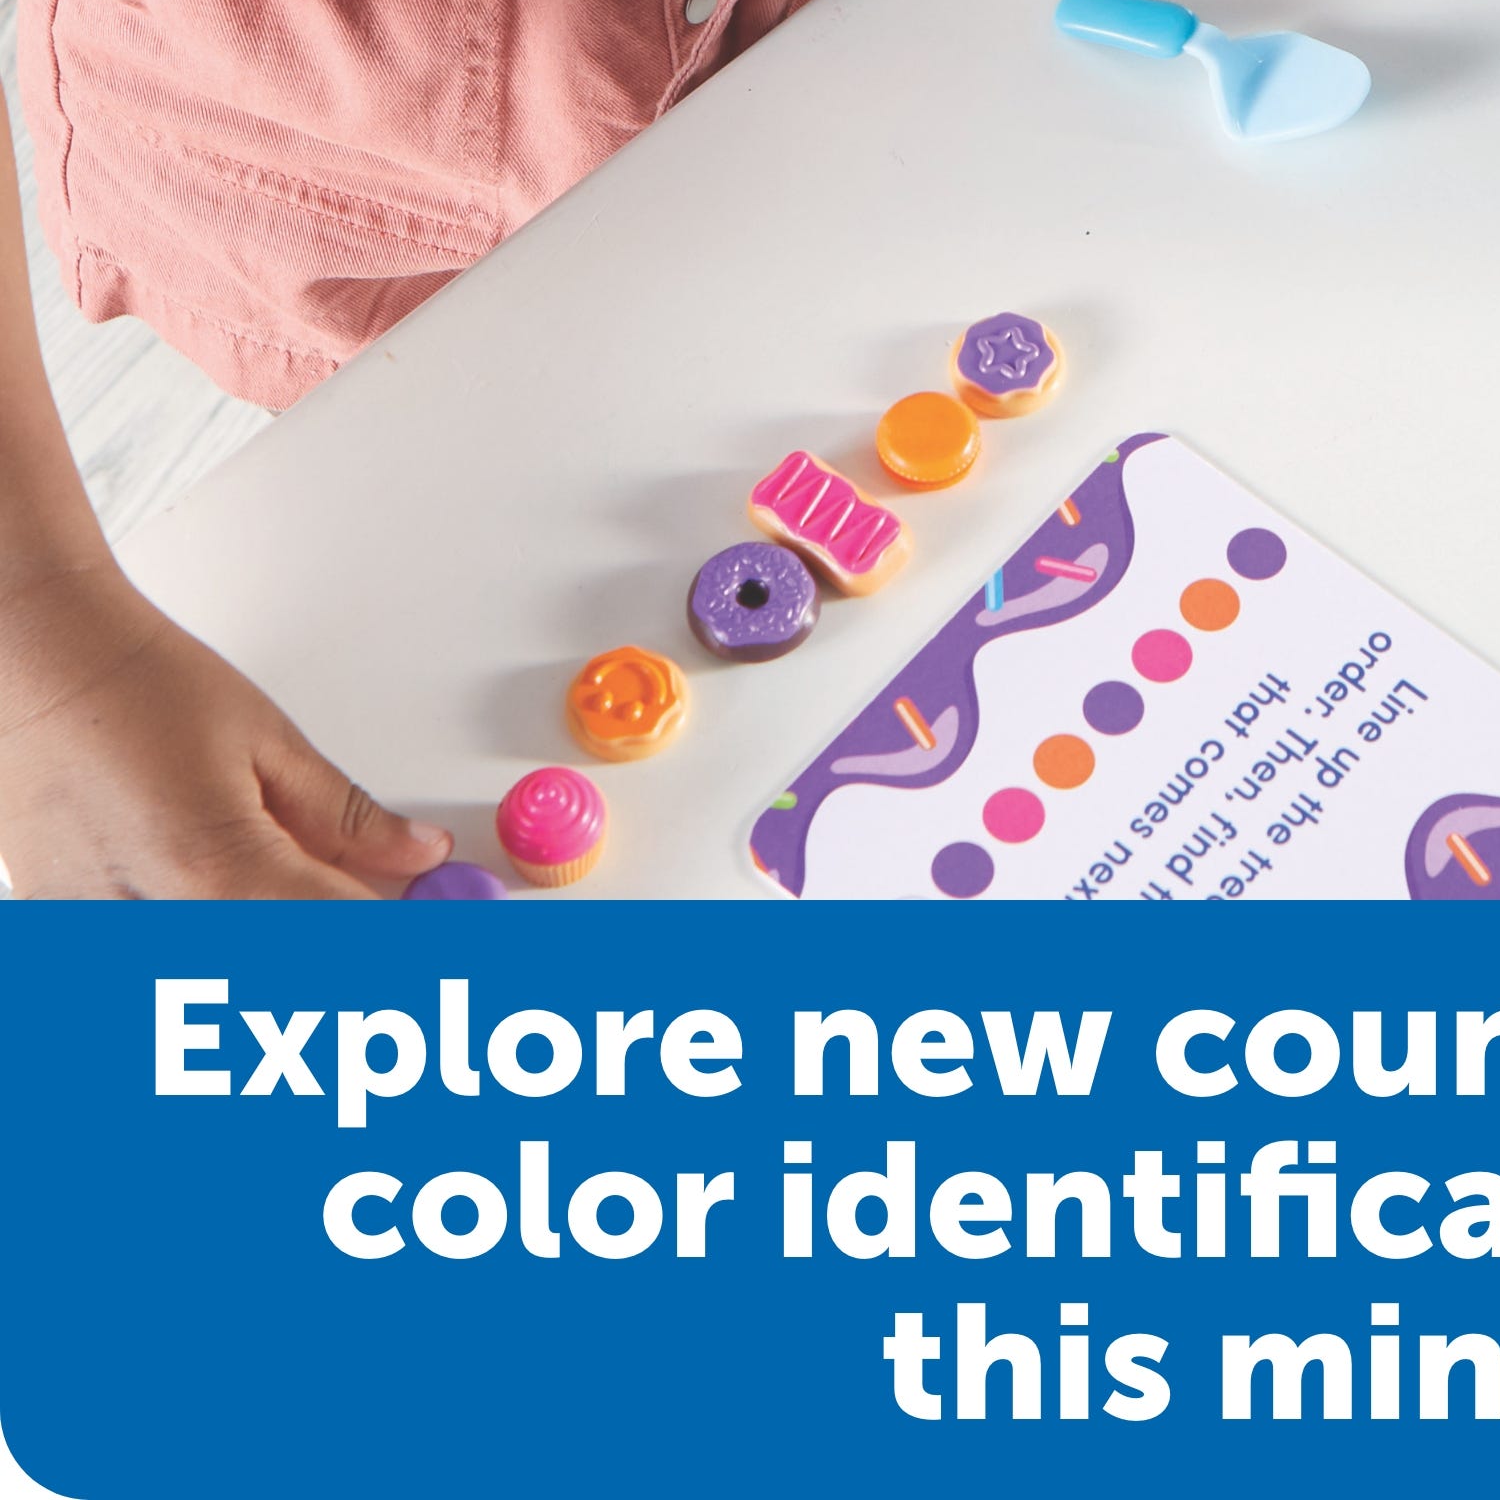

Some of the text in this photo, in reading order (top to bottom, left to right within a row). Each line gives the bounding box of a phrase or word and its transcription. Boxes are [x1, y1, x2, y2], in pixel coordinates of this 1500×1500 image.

[1304, 631, 1392, 718] order.
[1065, 673, 1291, 900] that comes nex
[1205, 679, 1429, 900] Line up the tre
[1224, 728, 1319, 801] Then,
[1165, 812, 1238, 886] find
